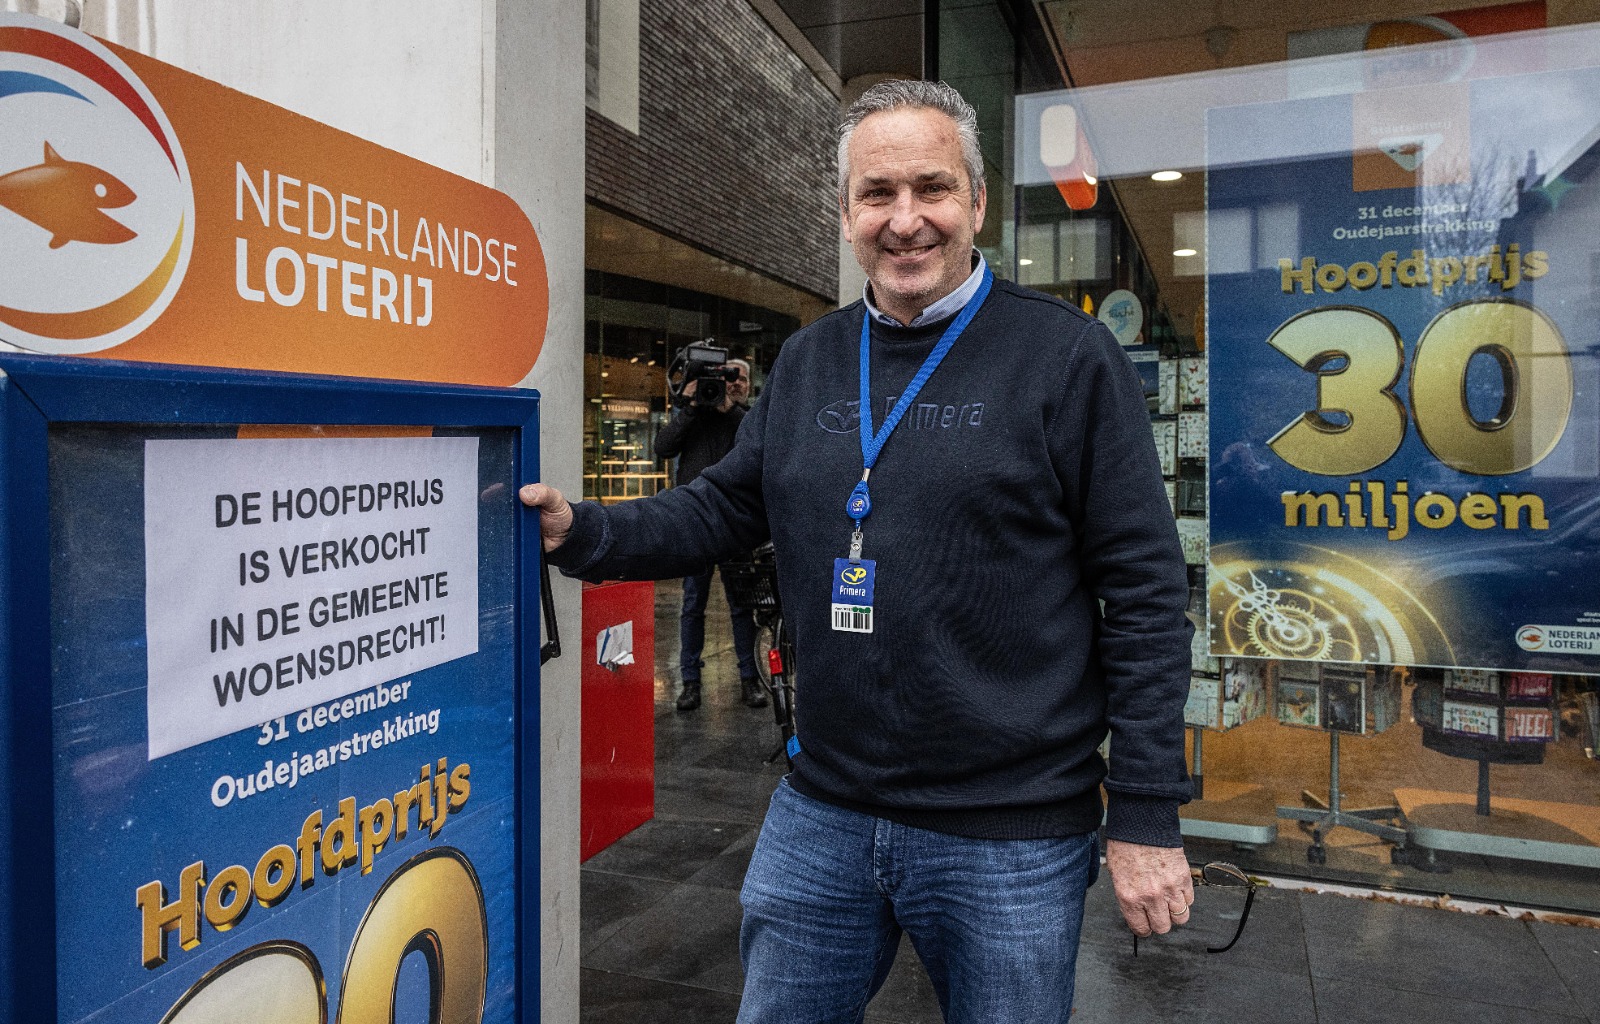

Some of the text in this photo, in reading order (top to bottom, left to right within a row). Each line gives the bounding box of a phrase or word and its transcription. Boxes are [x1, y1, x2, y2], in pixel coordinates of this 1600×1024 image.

[235, 161, 518, 287] NEDERLANDSE
[1332, 219, 1496, 240] Oudejaarstrekking
[1358, 202, 1468, 220] 31 december
[235, 237, 433, 327] LOTERIJ
[1279, 243, 1550, 296] Hoofdprijs
[885, 395, 985, 431] Pimera
[1265, 300, 1574, 477] 30
[215, 479, 444, 527] DE HOOFDPRIJS
[1281, 481, 1550, 540] miljoen
[240, 527, 431, 586] IS VERKOCHT
[210, 571, 450, 654] IN DE GEMEENTE
[839, 584, 866, 597] Primera
[212, 614, 447, 708] WOENSDRECHT!
[1549, 640, 1592, 649] LOTERIJ
[257, 679, 412, 747] 31 december
[211, 708, 441, 808] Oudejaarstrekking
[135, 757, 472, 970] Hoofdprijs
